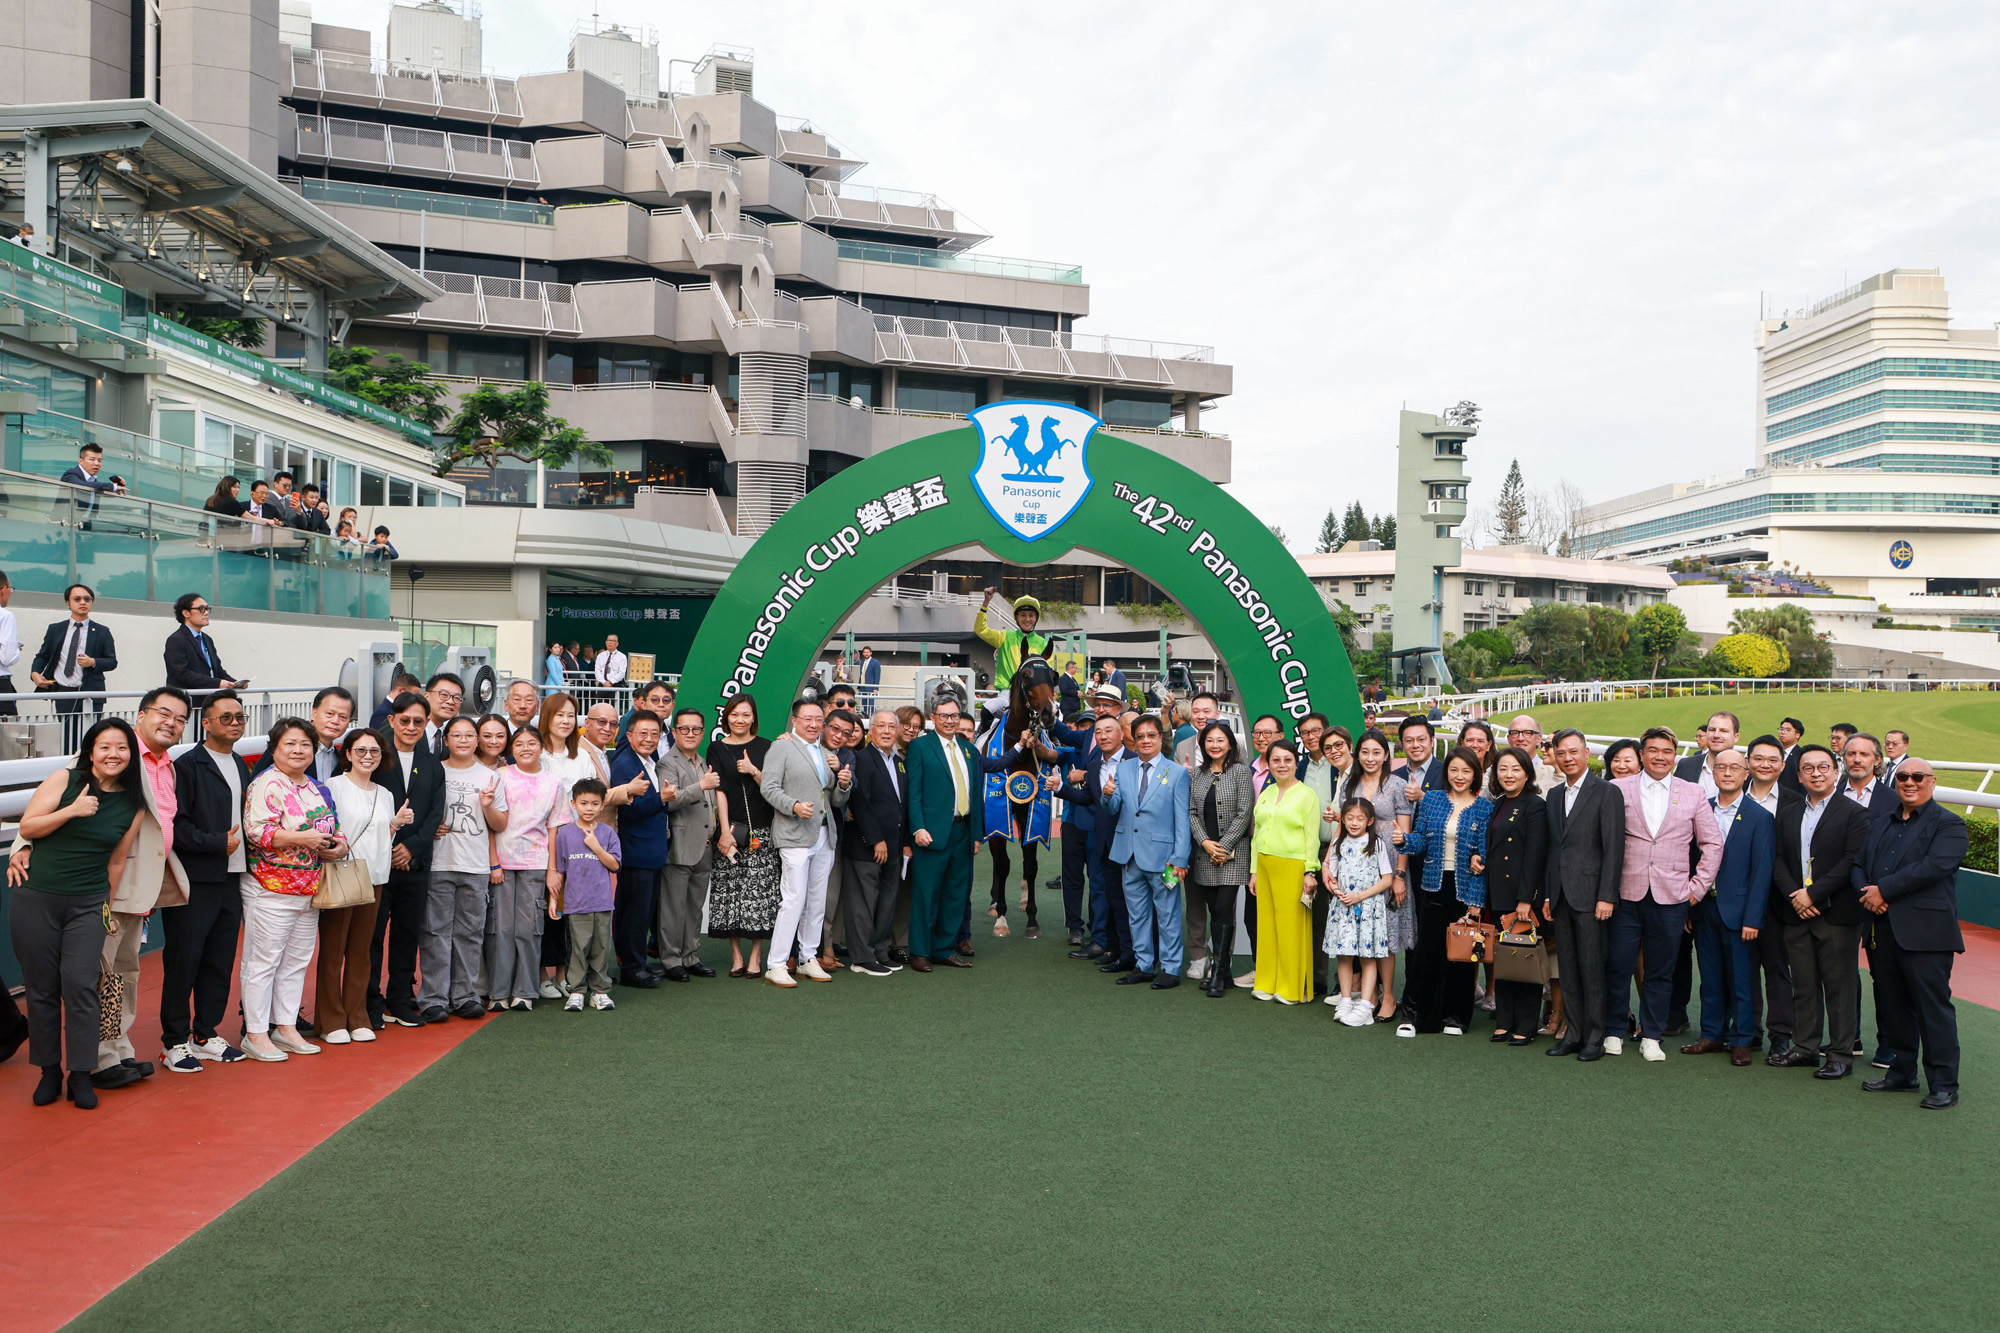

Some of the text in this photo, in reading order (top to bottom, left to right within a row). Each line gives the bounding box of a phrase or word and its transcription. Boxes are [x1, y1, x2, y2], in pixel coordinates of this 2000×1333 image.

[1002, 485, 1062, 498] Panasonic
[1022, 499, 1041, 510] Cup
[1431, 501, 1438, 513] 1
[1014, 512, 1048, 525] 樂聲盃
[722, 572, 815, 699] Panasonic
[805, 525, 860, 573] Cup
[856, 475, 950, 536] 樂聲盃
[1113, 482, 1312, 719] The 42nd Panasonic Cup
[546, 606, 681, 621] 2nd Panasonic Cup 樂聲盃
